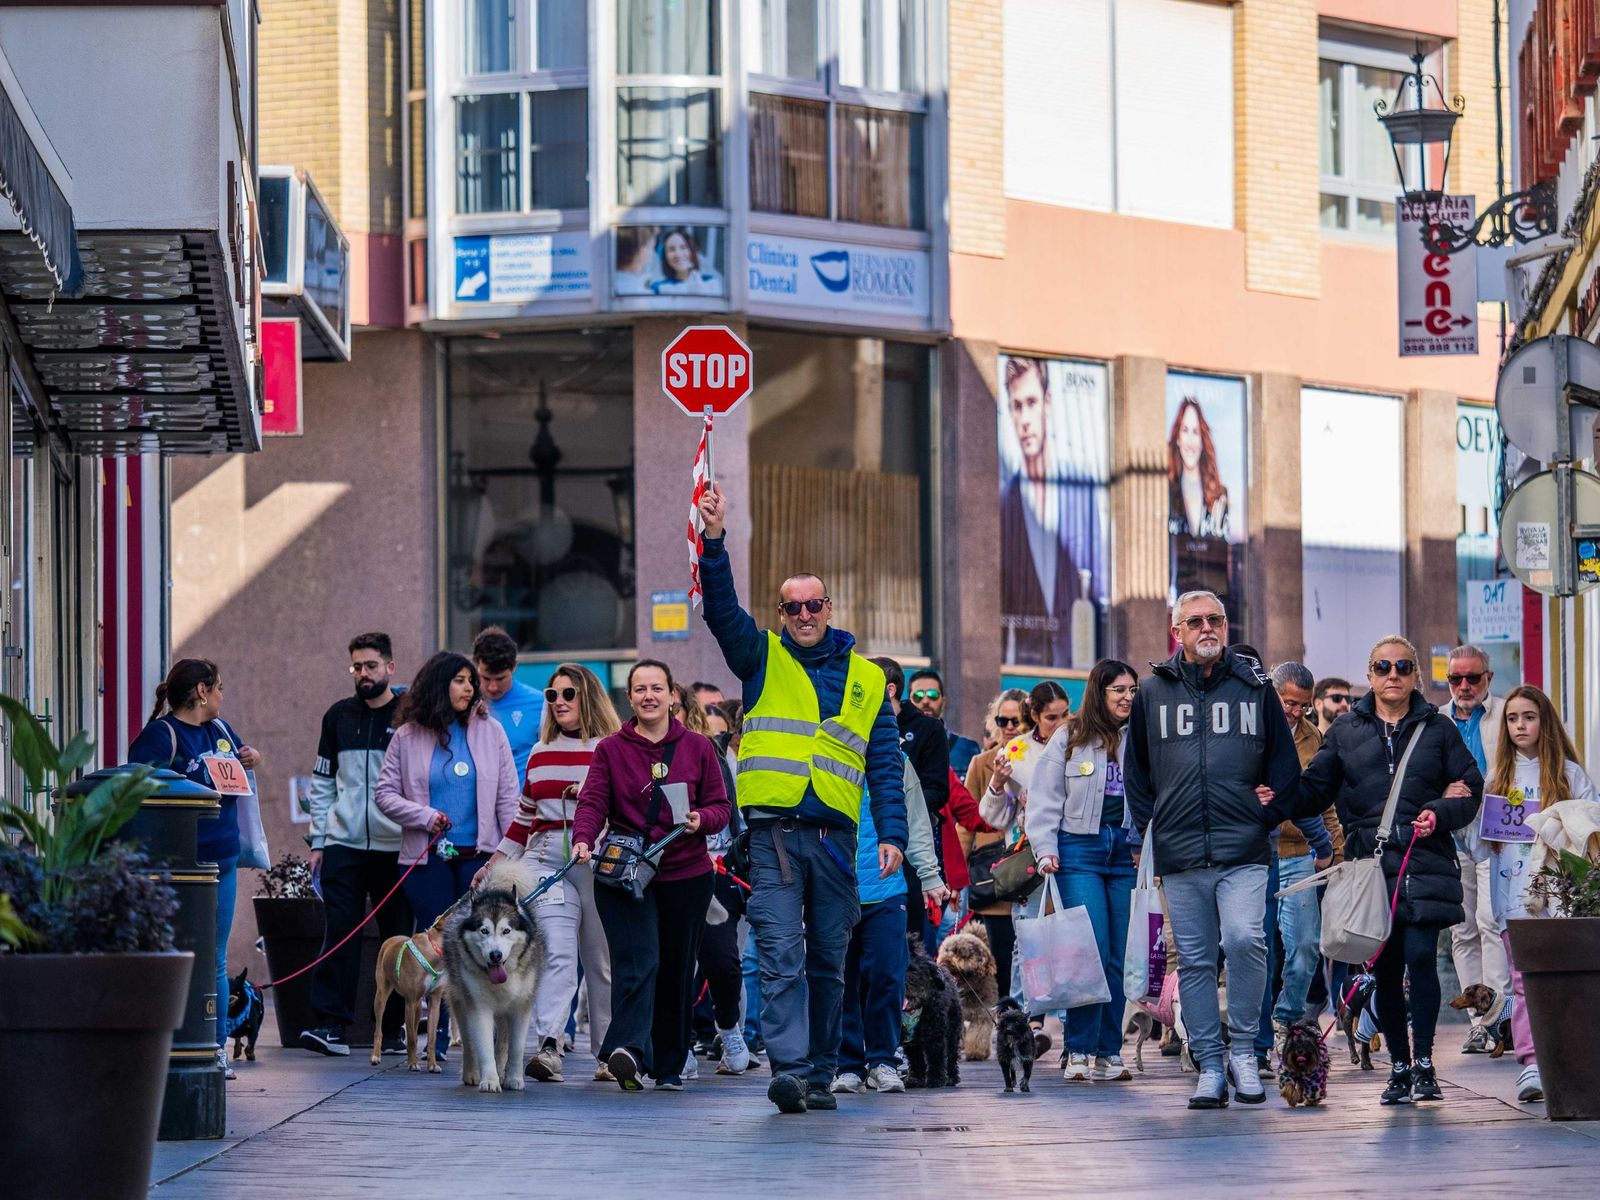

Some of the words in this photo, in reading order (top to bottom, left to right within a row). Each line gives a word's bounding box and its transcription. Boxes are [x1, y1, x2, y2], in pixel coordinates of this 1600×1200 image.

[749, 269, 797, 294] Dental
[669, 353, 746, 388] STOP
[1160, 702, 1256, 738] ICON
[218, 762, 236, 780] 02
[1501, 803, 1525, 826] 33
